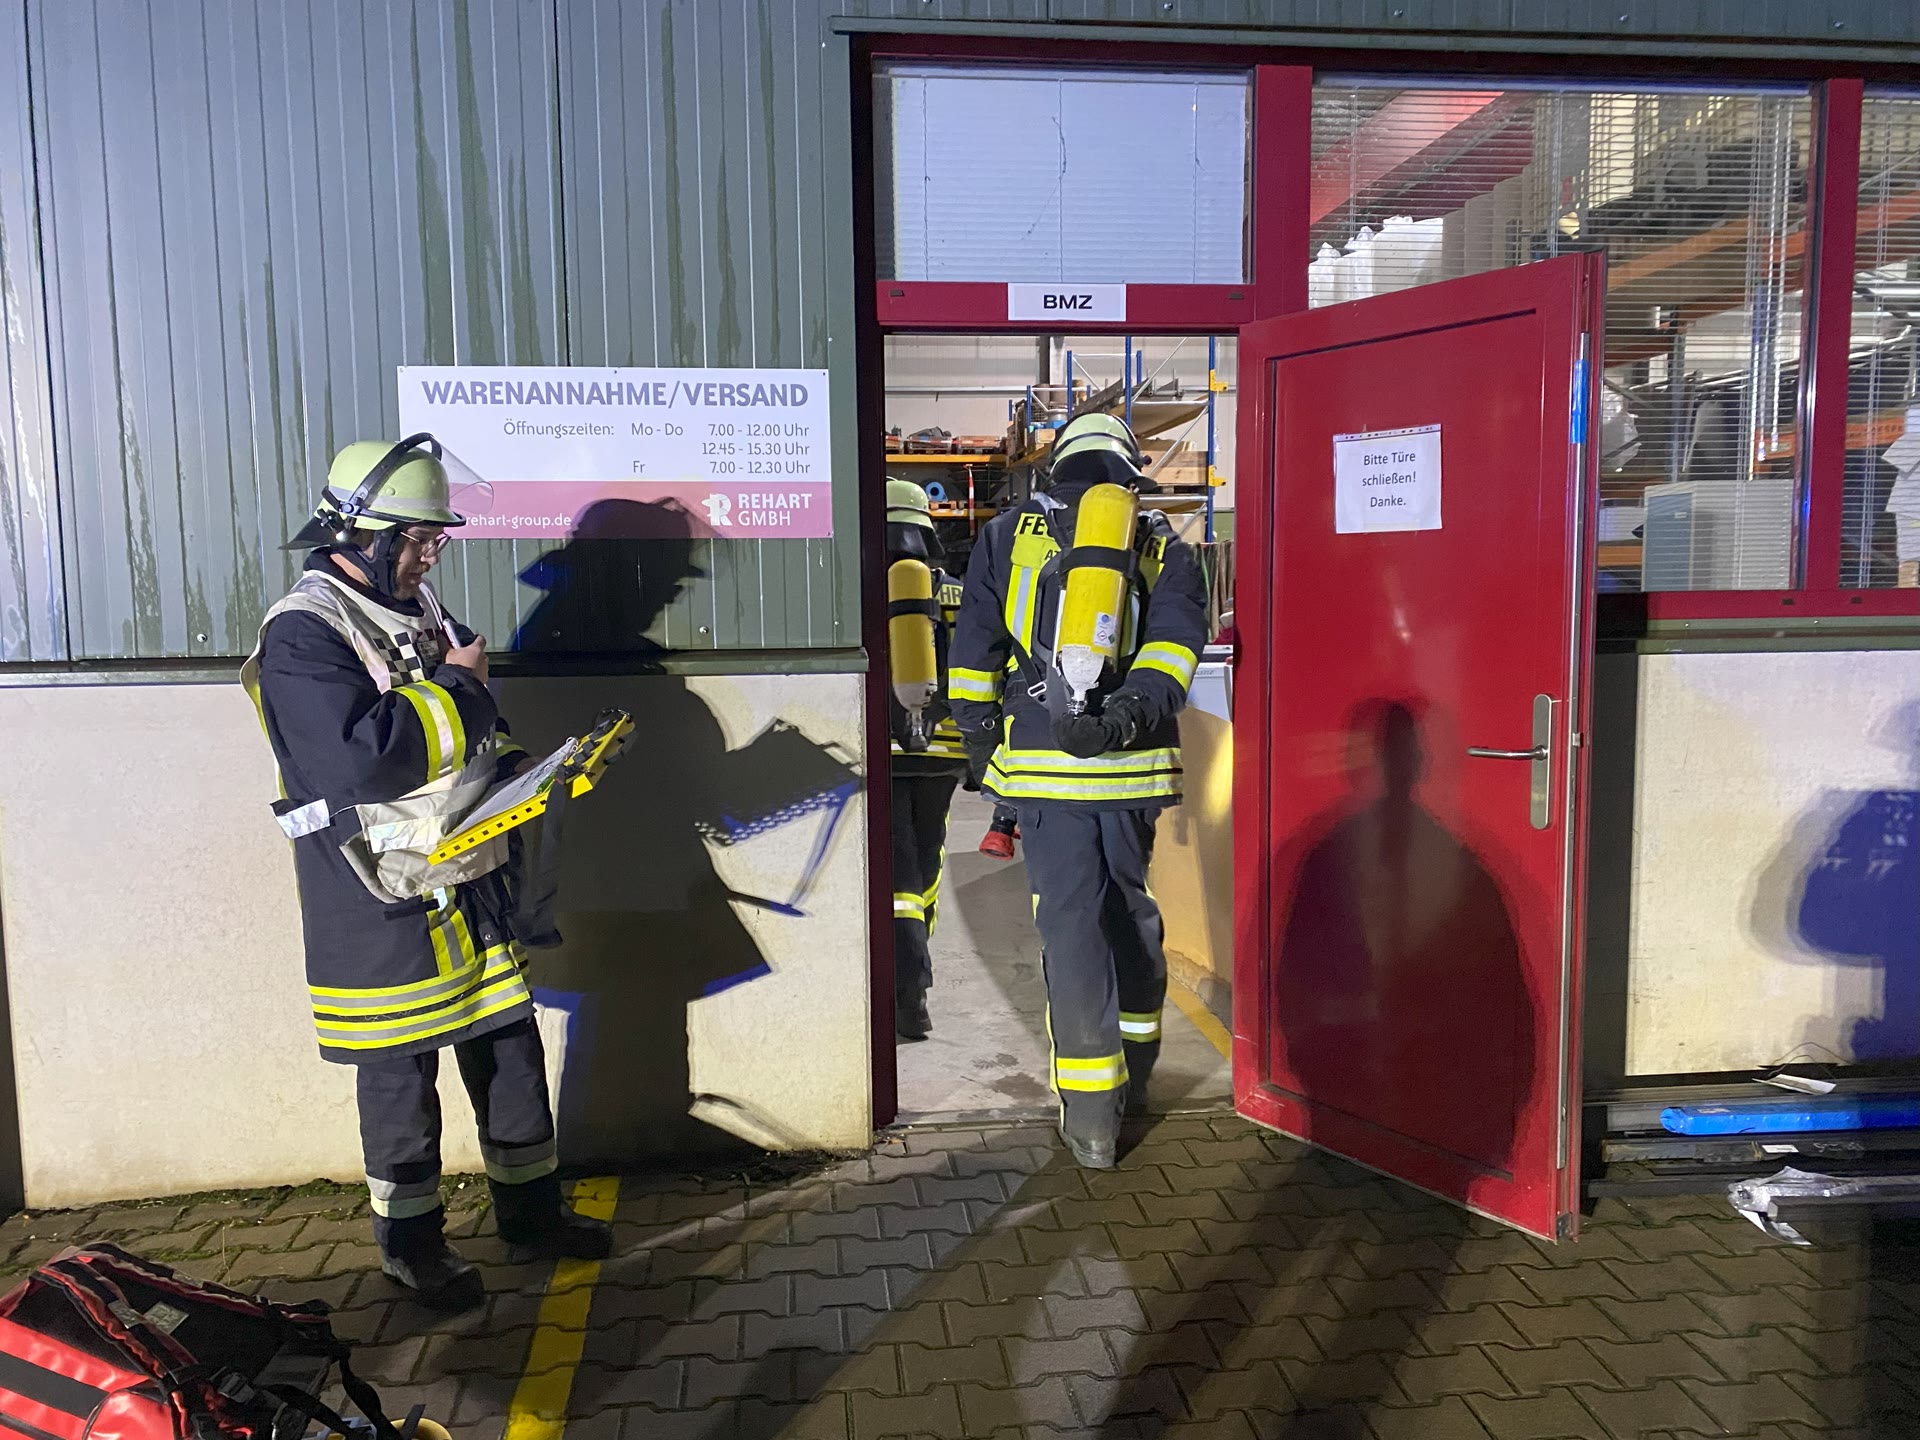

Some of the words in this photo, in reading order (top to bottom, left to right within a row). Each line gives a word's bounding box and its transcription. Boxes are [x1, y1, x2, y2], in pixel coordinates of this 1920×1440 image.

[1043, 294, 1093, 310] BMZ
[422, 381, 808, 408] WARENANNAHME/VERSAND
[503, 419, 614, 437] Öffnungszeiten:
[631, 423, 653, 435] Mo
[665, 424, 683, 436] Do
[708, 424, 734, 436] 7.00
[747, 424, 780, 436] 12.00
[785, 424, 809, 436] Uhr
[702, 443, 735, 455] 12.45
[748, 443, 781, 455] 15.30
[785, 443, 810, 455] Uhr
[1364, 454, 1388, 465] Bitte
[1392, 452, 1415, 463] Türe
[633, 461, 645, 473] Fr
[709, 461, 735, 473] 7.00
[747, 462, 781, 474] 12.30
[786, 462, 810, 474] Uhr
[1362, 471, 1416, 486] schließen!
[738, 494, 811, 509] REHART
[1371, 495, 1406, 507] Danke.
[738, 511, 791, 526] GMBH
